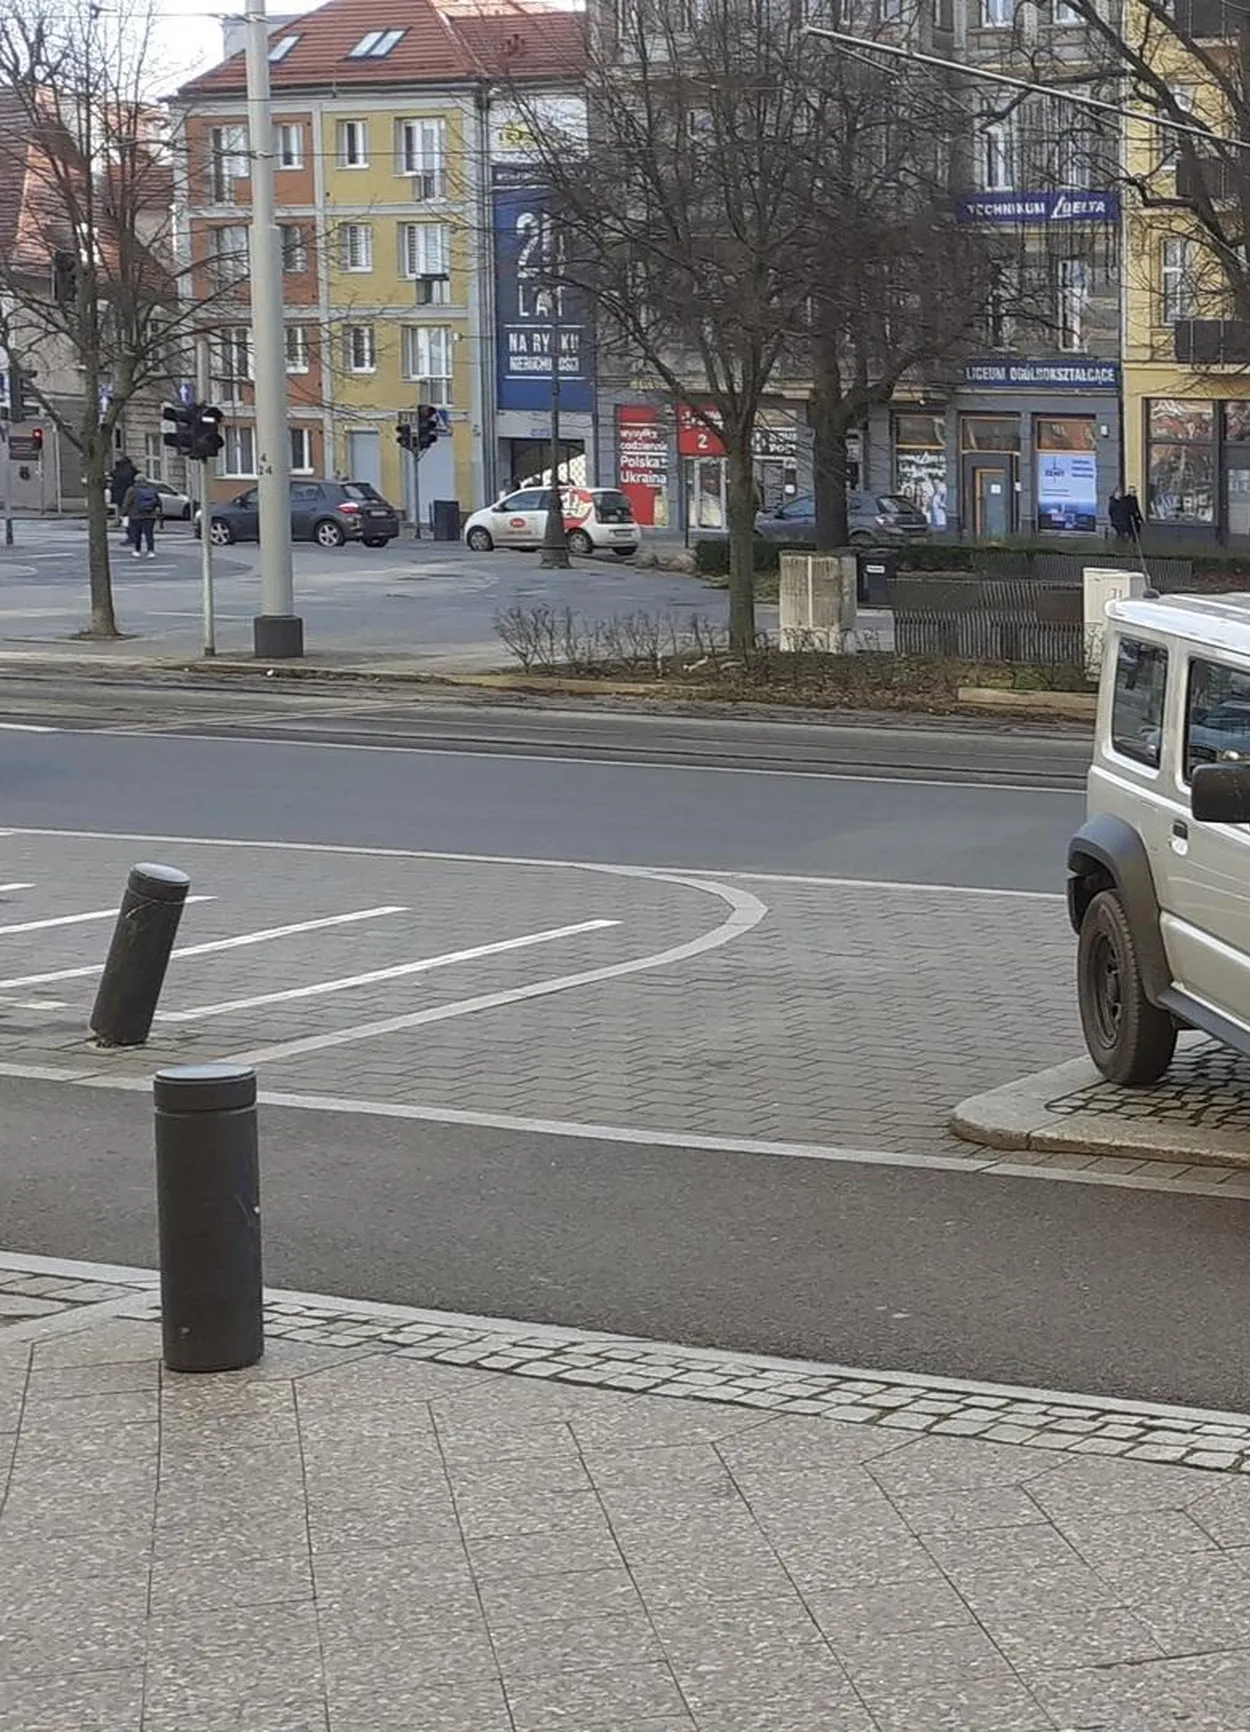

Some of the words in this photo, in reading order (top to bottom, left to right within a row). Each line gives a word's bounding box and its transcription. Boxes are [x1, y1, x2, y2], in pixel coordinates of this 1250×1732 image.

[508, 332, 528, 353] NA
[965, 366, 1007, 381] LICEUM
[697, 433, 709, 449] 2
[620, 456, 660, 469] Polska
[620, 470, 668, 484] Ukraina
